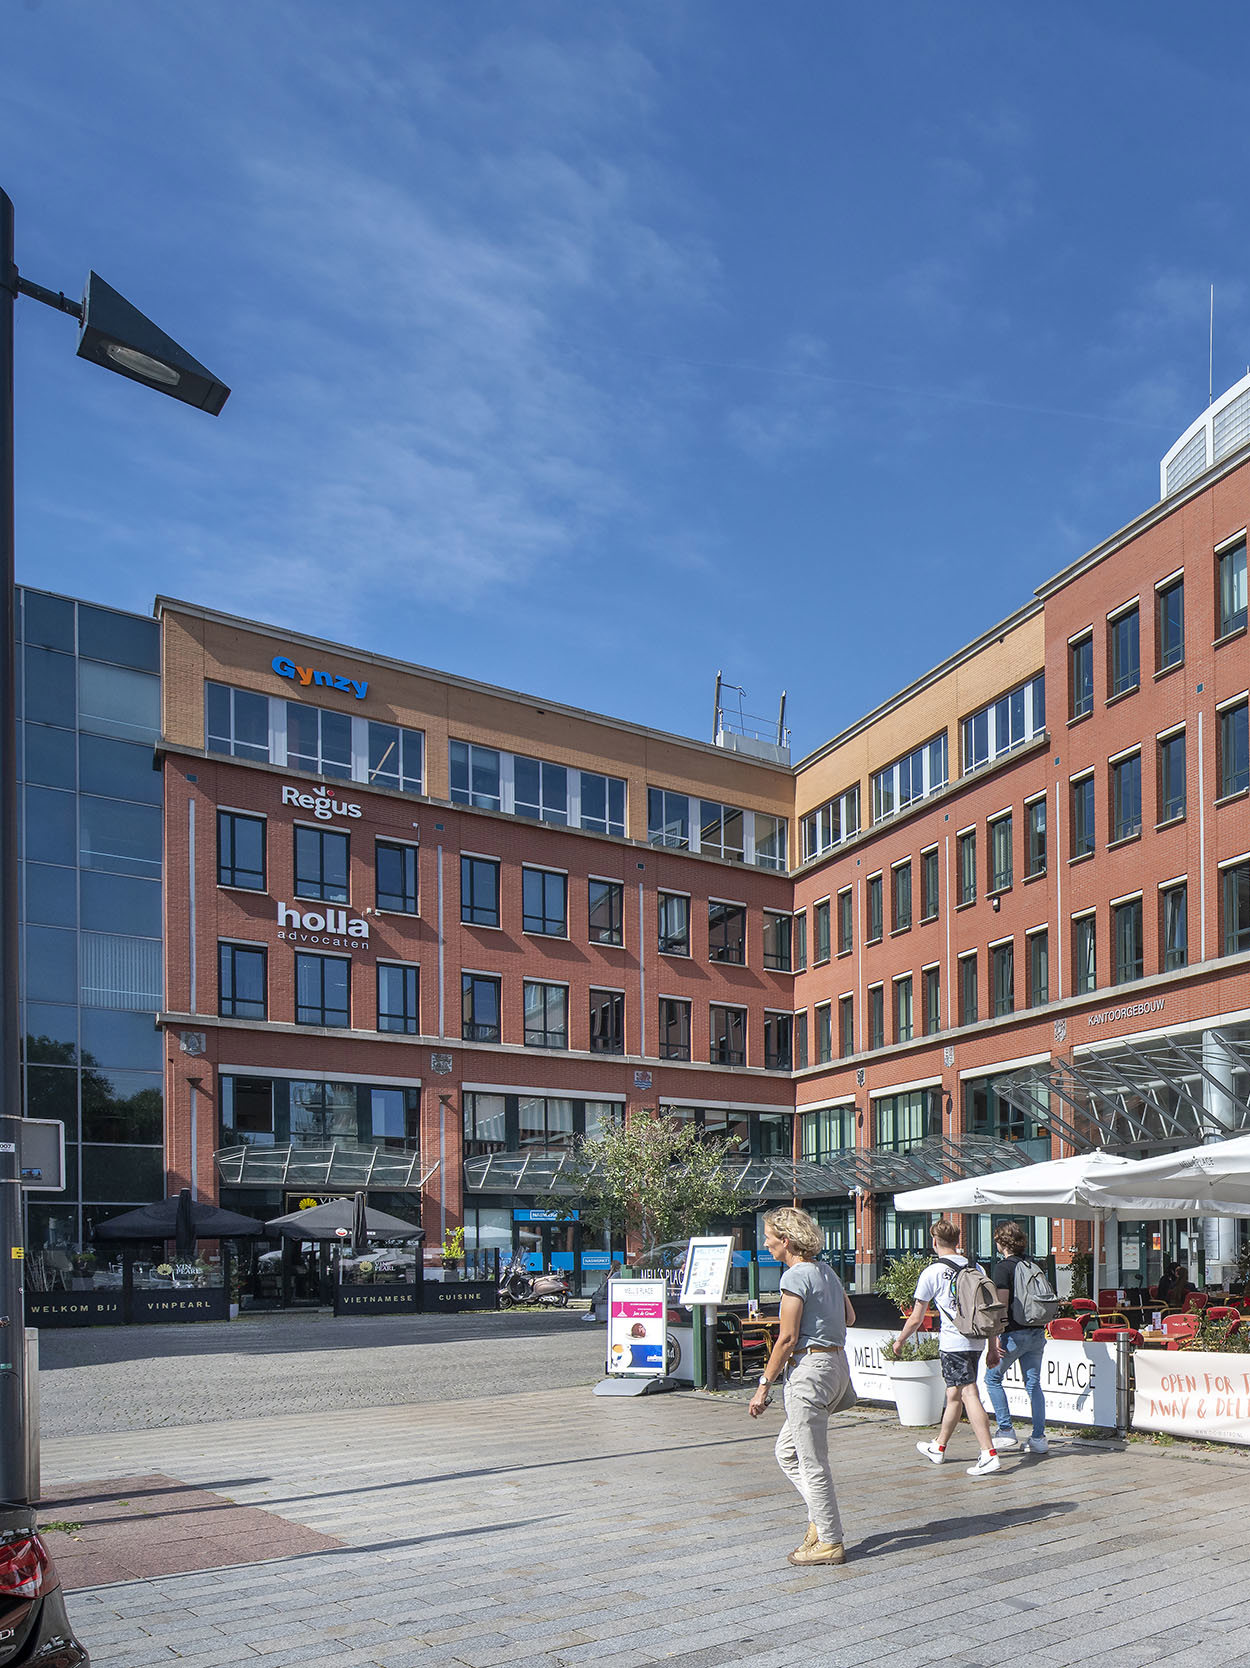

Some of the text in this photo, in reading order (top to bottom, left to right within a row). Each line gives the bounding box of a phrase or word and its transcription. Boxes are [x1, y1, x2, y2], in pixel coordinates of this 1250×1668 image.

[271, 656, 369, 699] Gynzy
[281, 785, 363, 820] Regus
[277, 901, 370, 939] holla
[277, 930, 370, 950] advocaten
[1087, 999, 1166, 1027] KANTOORGEBOUW
[147, 1300, 212, 1310] VINPEARL
[343, 1295, 413, 1304] VIETNAMESE
[439, 1292, 481, 1301] CUISINE
[31, 1304, 118, 1313] WELKOM BIJ
[1047, 1360, 1097, 1390] PLACE
[1160, 1373, 1197, 1393] OPEN
[1203, 1372, 1235, 1395] FOR
[1150, 1397, 1190, 1419] AWAY
[1196, 1398, 1207, 1419] &
